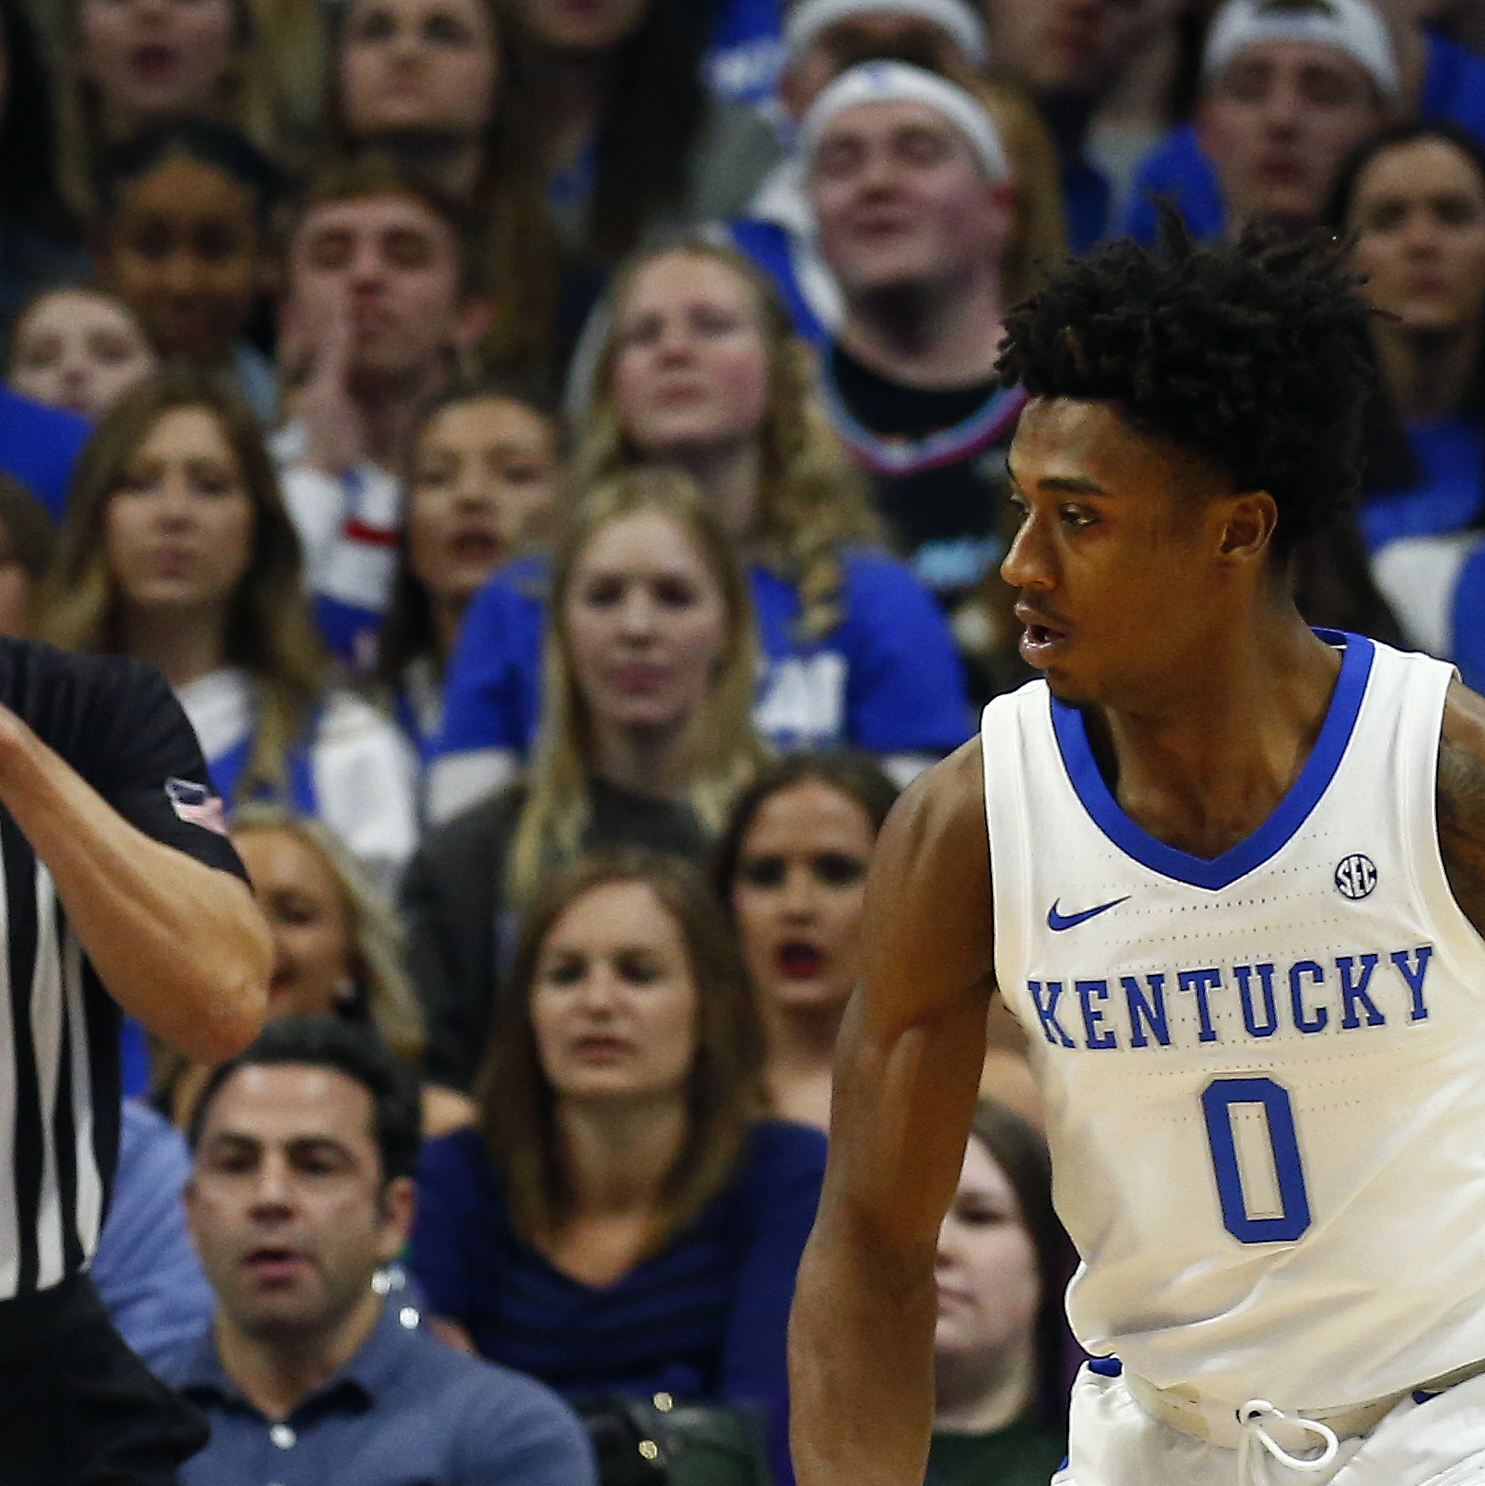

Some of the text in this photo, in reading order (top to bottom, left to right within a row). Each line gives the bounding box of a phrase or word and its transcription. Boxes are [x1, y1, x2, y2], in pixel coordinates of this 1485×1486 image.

[1335, 855, 1376, 899] SEC
[1028, 944, 1433, 1050] KENTUCKY
[1199, 1073, 1312, 1245] 0
